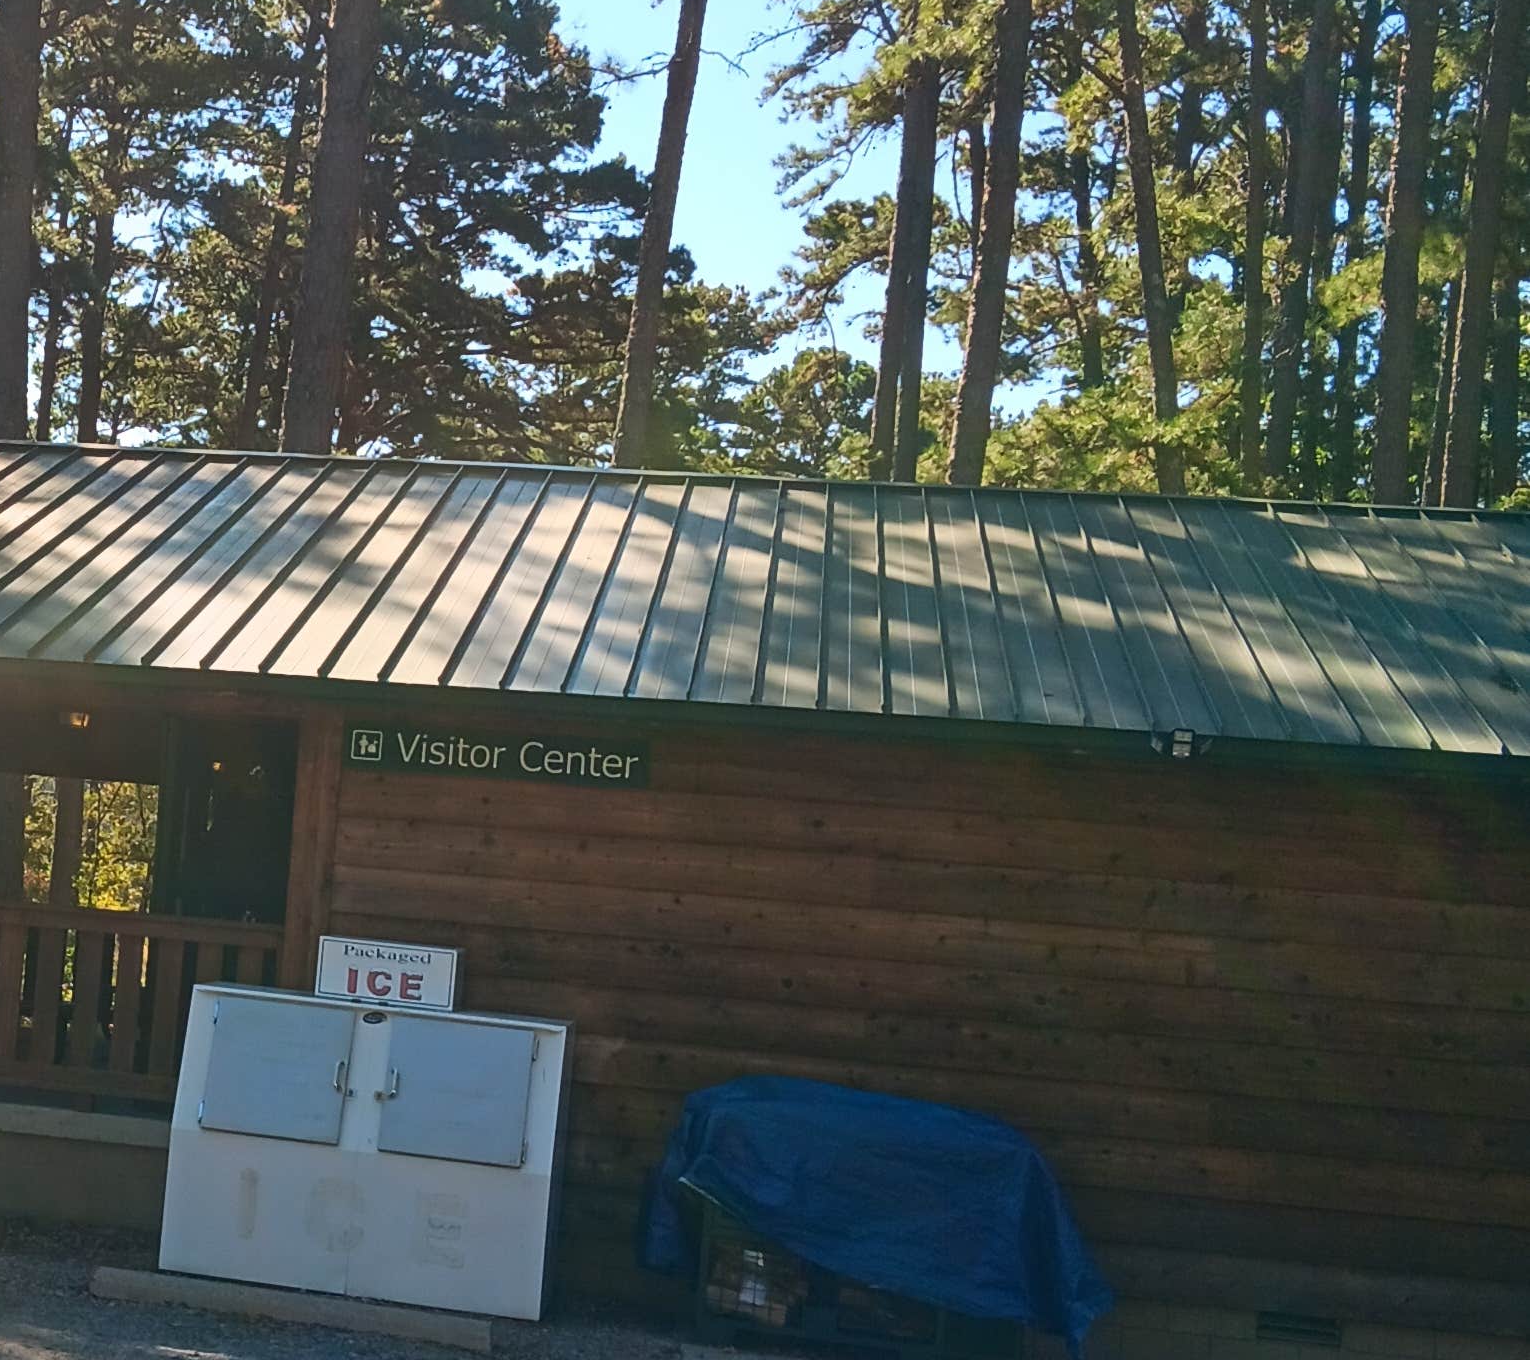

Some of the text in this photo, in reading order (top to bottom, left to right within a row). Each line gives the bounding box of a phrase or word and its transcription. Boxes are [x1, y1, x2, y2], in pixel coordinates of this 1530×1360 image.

[397, 732, 639, 779] Visitor Center
[343, 944, 432, 964] Packaged
[346, 967, 424, 1000] ICE
